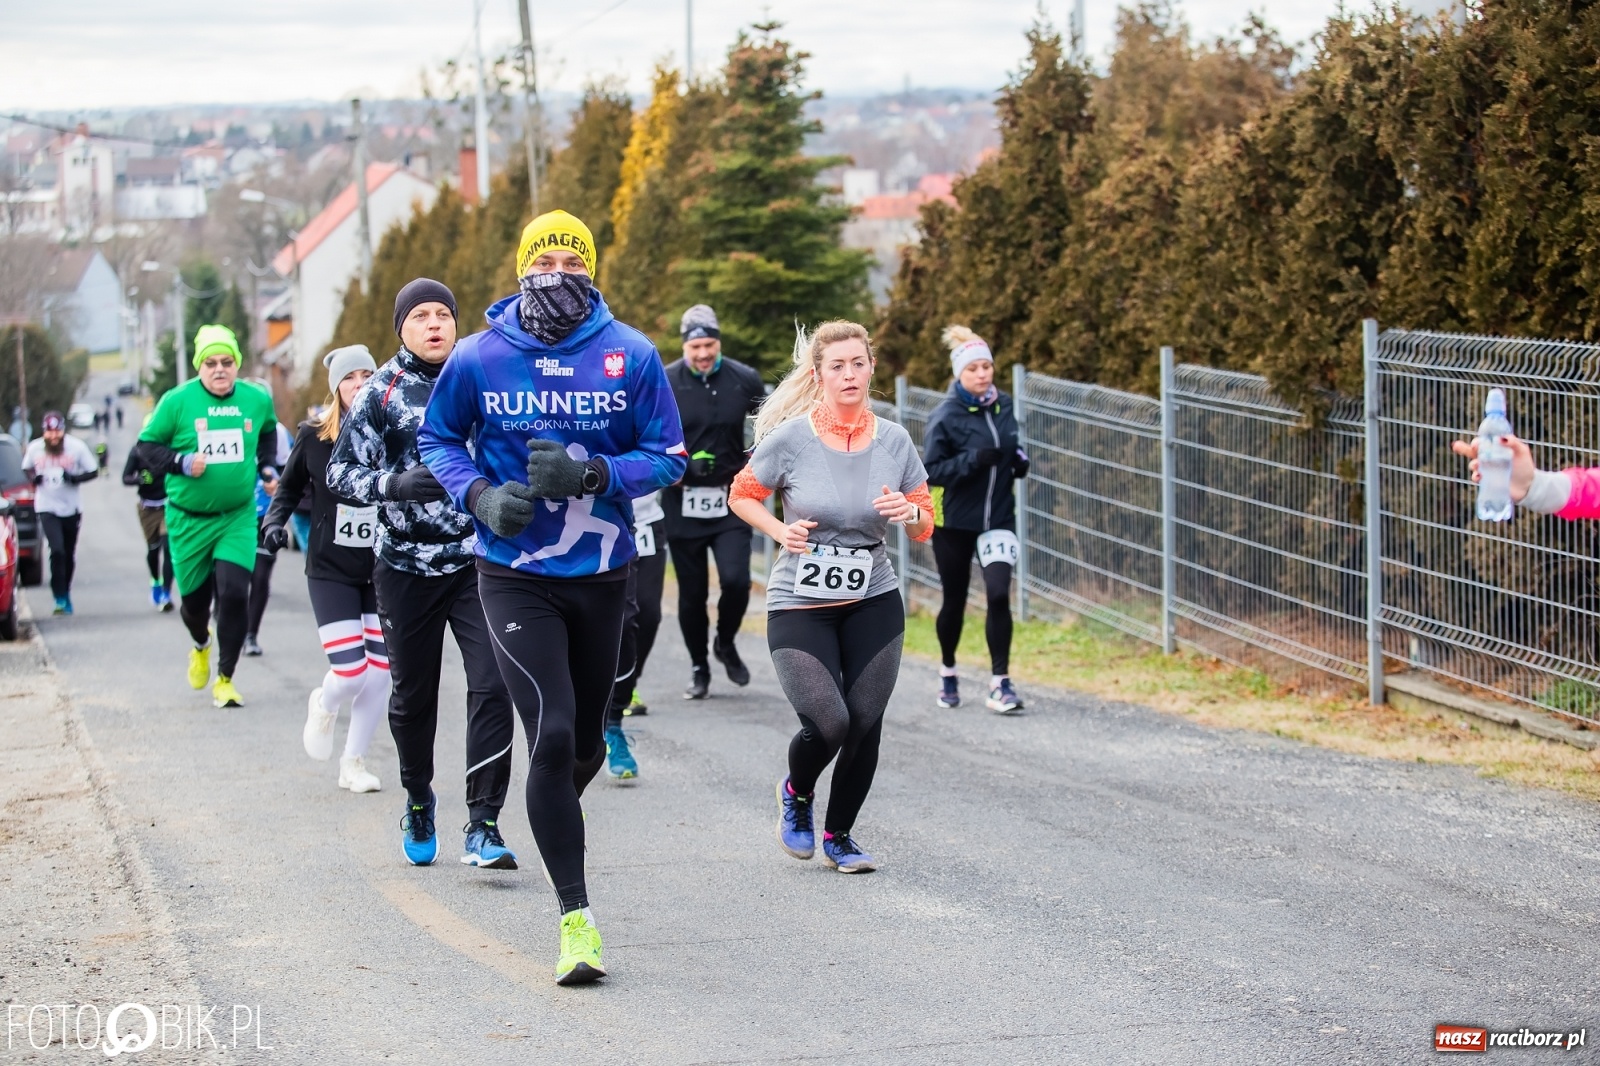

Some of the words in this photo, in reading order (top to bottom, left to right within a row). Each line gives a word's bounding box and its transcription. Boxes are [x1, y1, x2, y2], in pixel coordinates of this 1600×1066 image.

[482, 390, 627, 415] RUNNERS
[207, 405, 243, 417] KAROL
[502, 419, 572, 431] EKO-OKNA
[573, 419, 610, 431] TEAM
[202, 442, 238, 456] 441
[687, 497, 724, 512] 154
[339, 521, 372, 539] 46
[983, 542, 1018, 560] 416
[800, 562, 866, 591] 269
